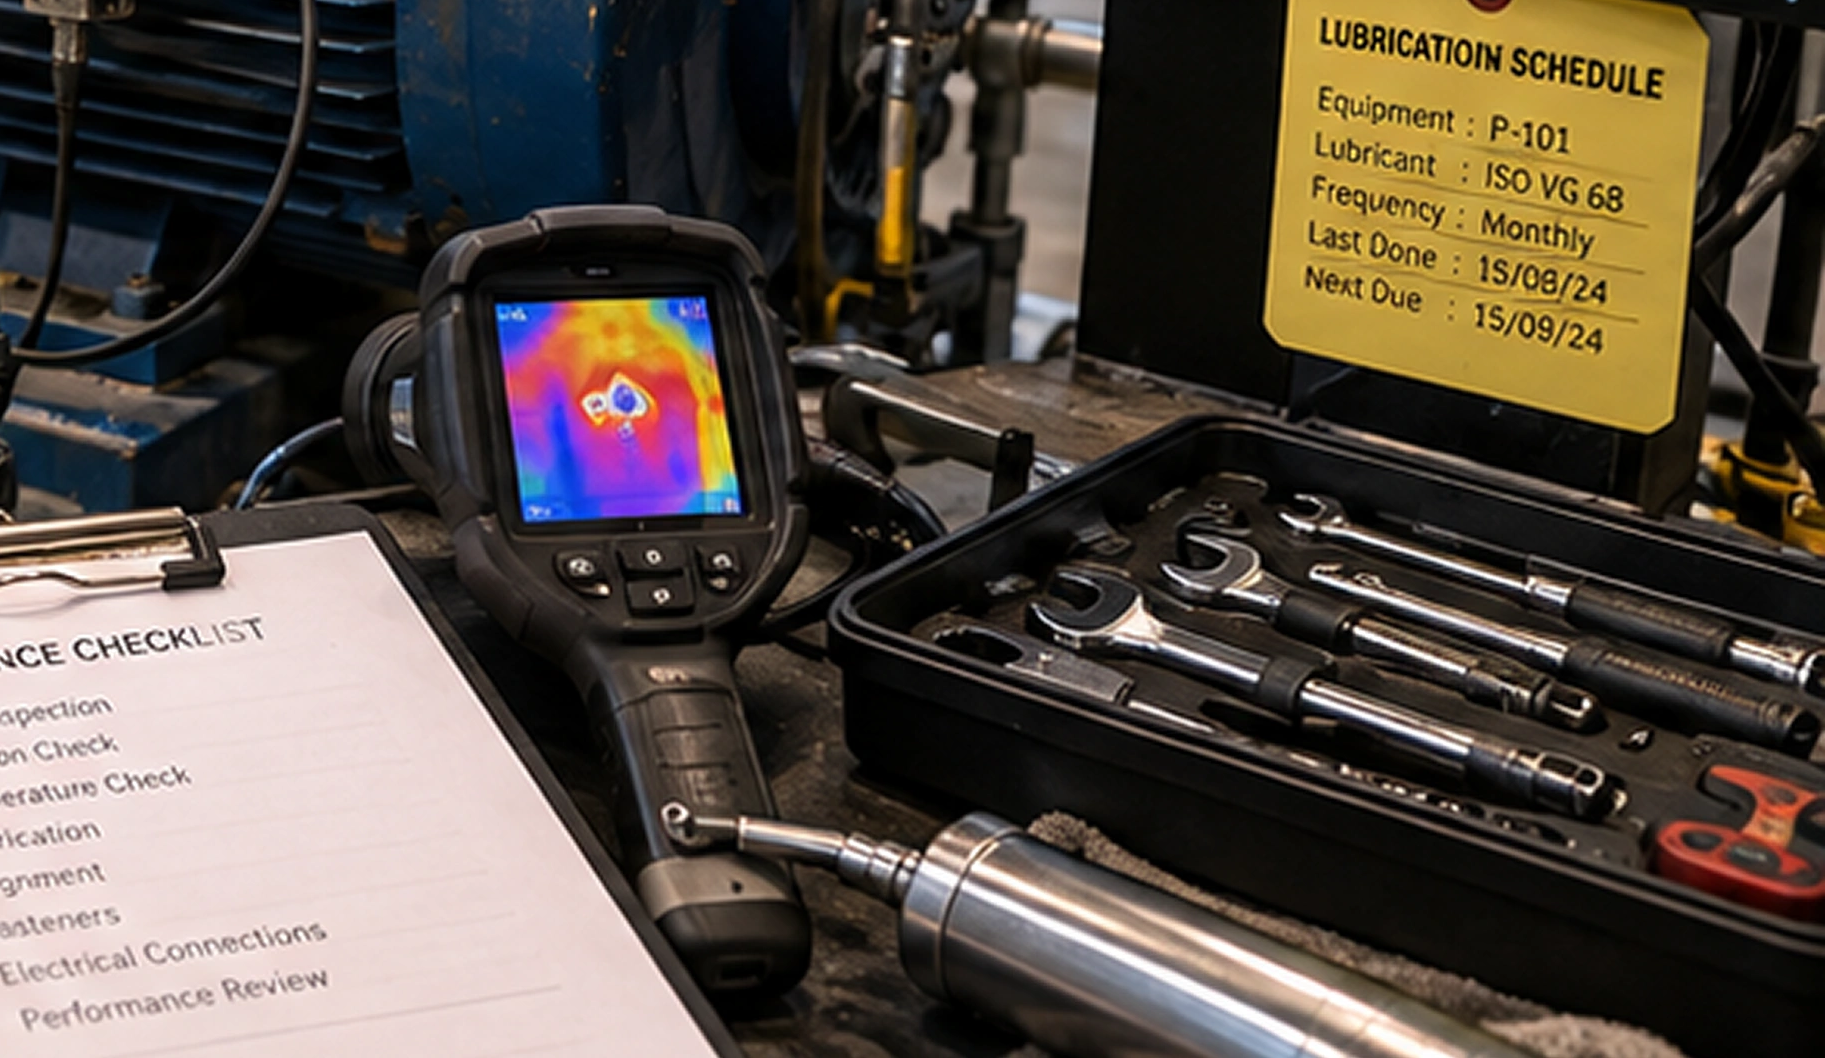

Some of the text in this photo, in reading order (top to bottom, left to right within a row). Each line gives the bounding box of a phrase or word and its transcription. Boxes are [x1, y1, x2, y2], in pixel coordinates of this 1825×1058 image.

[1509, 47, 1666, 100] SCHEDULE
[1317, 85, 1455, 135] Equipment
[1490, 114, 1569, 154] P-101
[1314, 131, 1436, 178] Lubricant
[1485, 162, 1531, 195] ISO
[1540, 172, 1579, 205] VG
[1586, 184, 1624, 213] 68
[1312, 175, 1446, 230] Frequency
[1481, 209, 1595, 260] Monthly
[1308, 221, 1362, 255] Last
[1368, 231, 1437, 270] Done
[1304, 265, 1363, 300] Next
[1371, 278, 1422, 313] Due
[1474, 303, 1605, 355] 15/09/24
[72, 617, 267, 663] CHECKLIST
[32, 732, 119, 762] Check
[103, 764, 193, 796] Check
[143, 921, 328, 966] Connections
[18, 966, 331, 1033] Performance Review
